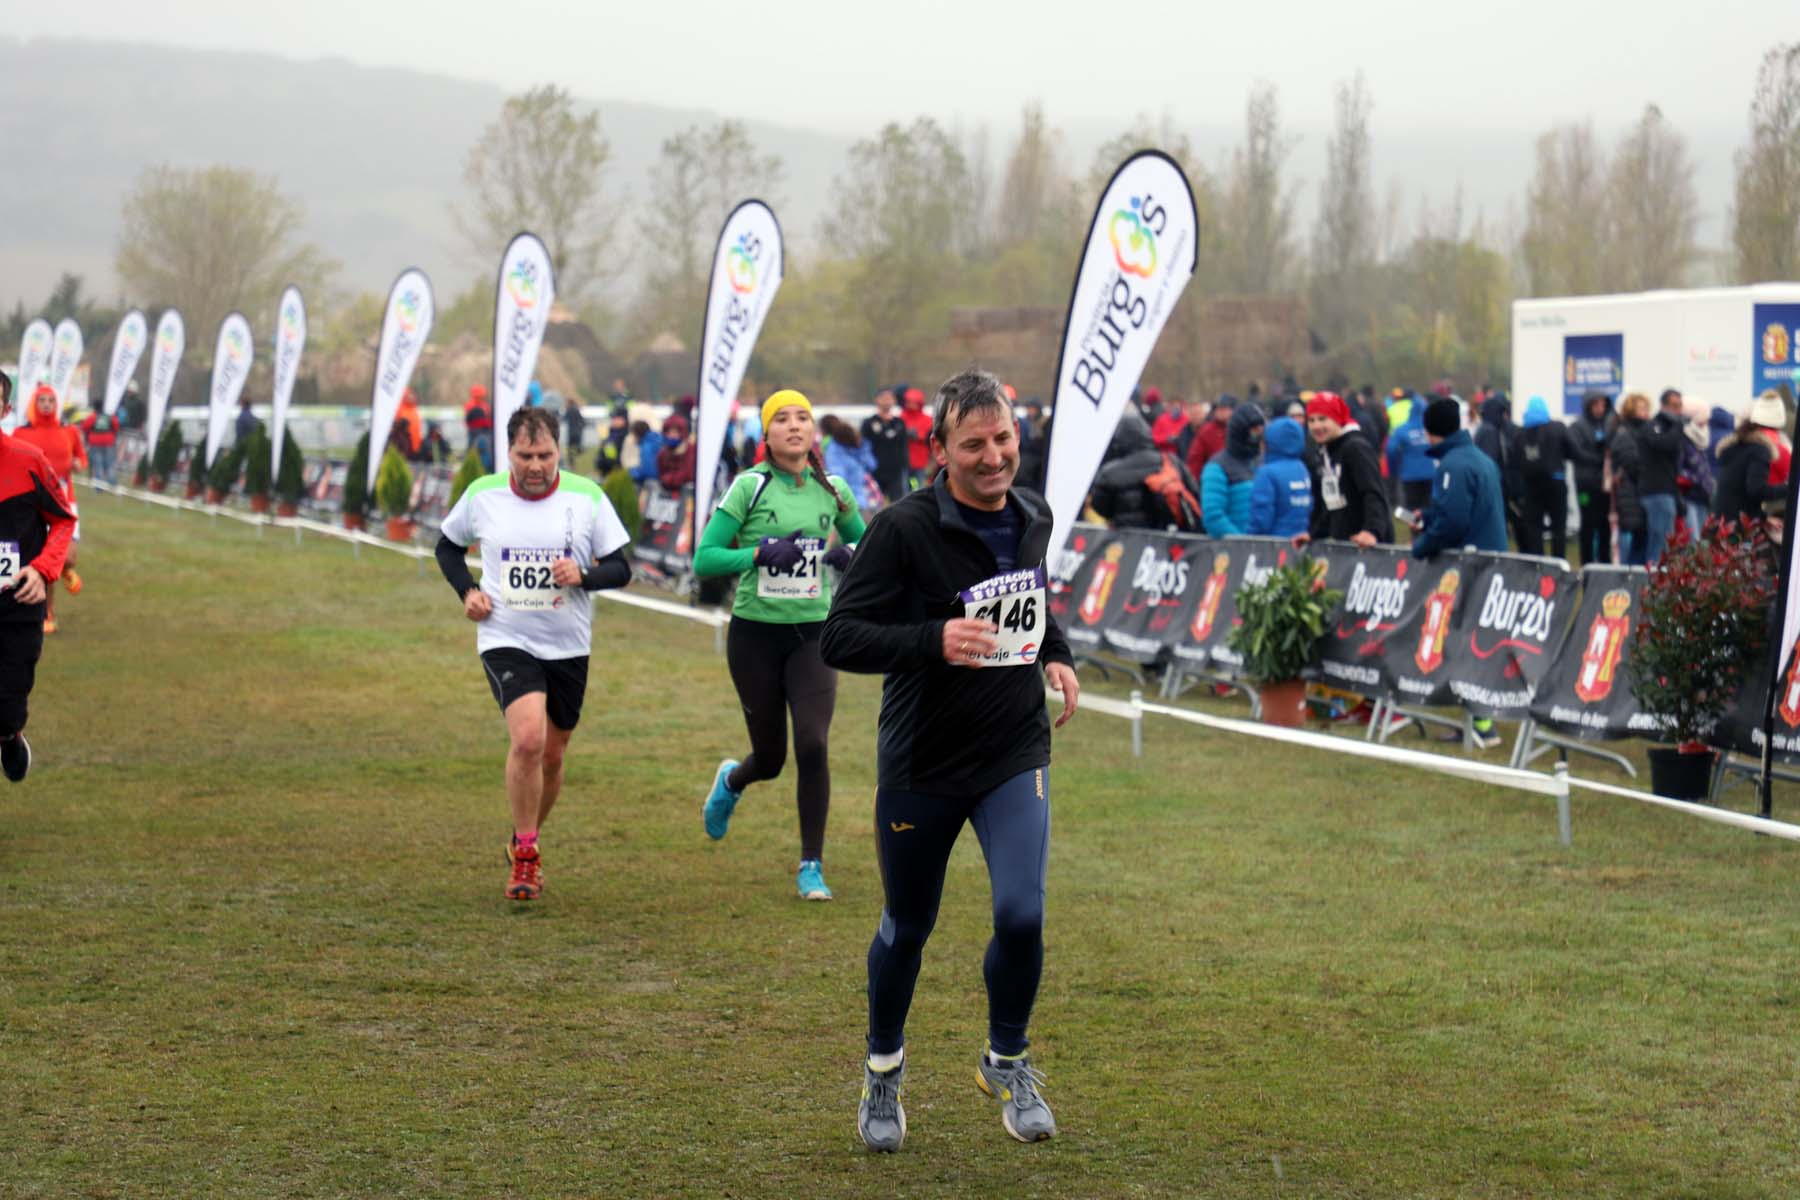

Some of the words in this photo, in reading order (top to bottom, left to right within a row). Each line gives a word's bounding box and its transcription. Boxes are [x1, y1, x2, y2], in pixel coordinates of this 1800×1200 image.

[508, 566, 562, 590] 662
[972, 579, 1037, 601] BURGOS
[1345, 561, 1410, 632] Burgos
